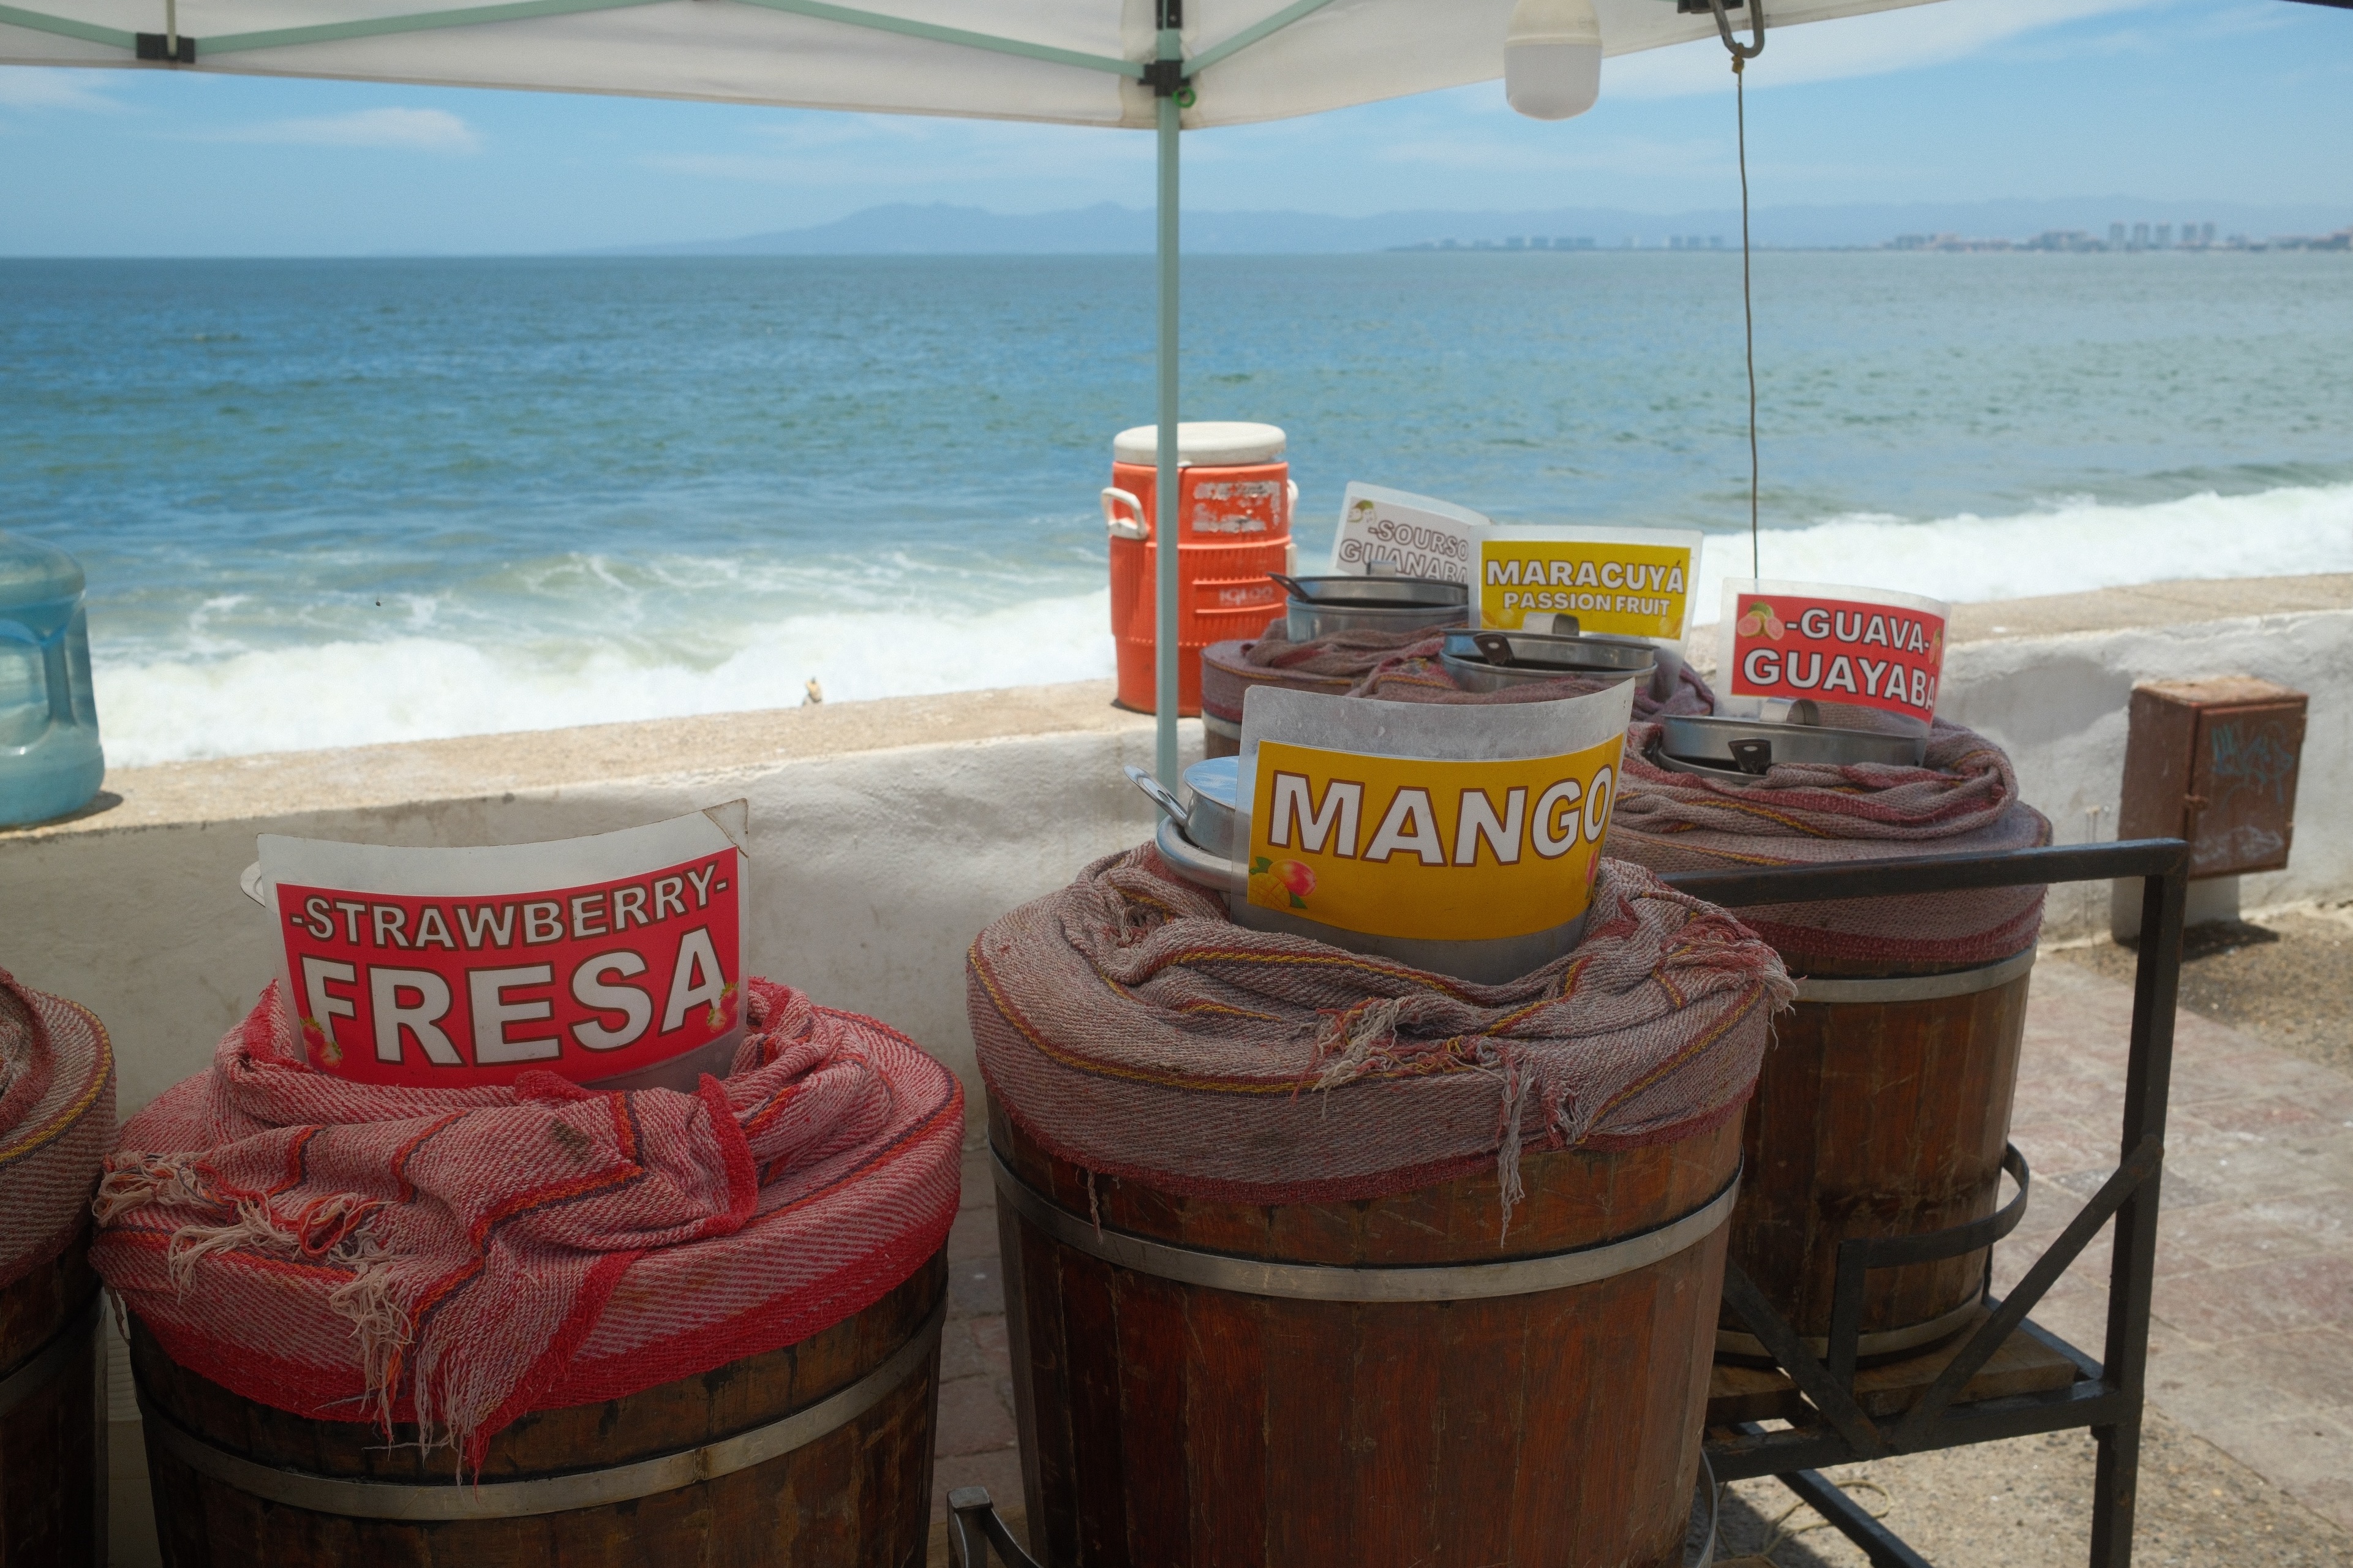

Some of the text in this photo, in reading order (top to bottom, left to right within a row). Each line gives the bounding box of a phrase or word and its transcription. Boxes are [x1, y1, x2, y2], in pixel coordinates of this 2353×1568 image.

[1486, 559, 1684, 594] MARACUYÁ
[1504, 591, 1671, 616] PASSION FRUIT
[1786, 608, 1930, 655] -GUAVA-
[1744, 648, 1934, 711] GUAYABA
[1268, 764, 1613, 867] MANGO
[291, 860, 729, 951] -STRAWBERRY-
[299, 925, 726, 1067] FRESA
